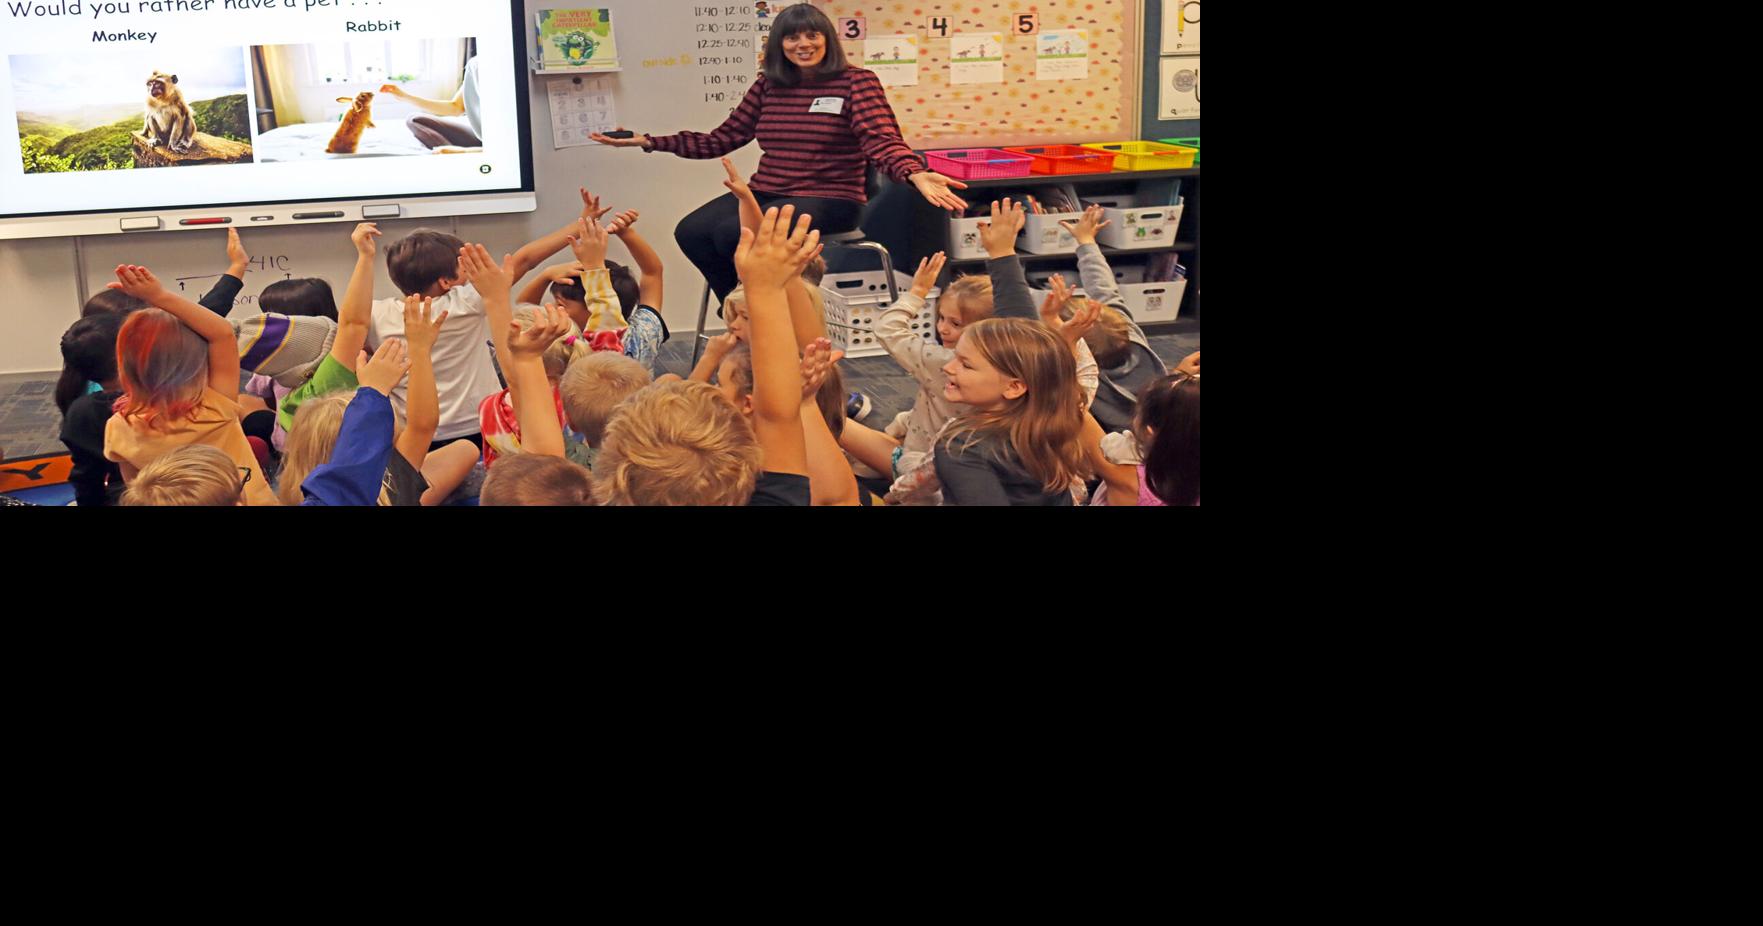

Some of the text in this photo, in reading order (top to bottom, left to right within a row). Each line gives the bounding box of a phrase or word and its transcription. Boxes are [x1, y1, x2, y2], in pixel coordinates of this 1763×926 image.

[7, 0, 82, 17] Would
[90, 2, 130, 19] you
[139, 0, 214, 13] rather
[569, 10, 592, 18] VERY
[346, 19, 401, 33] Rabbit
[845, 19, 861, 39] 3
[932, 17, 948, 37] 4
[1018, 15, 1033, 34] 5
[92, 29, 157, 44] Monkey
[599, 111, 608, 121] 7
